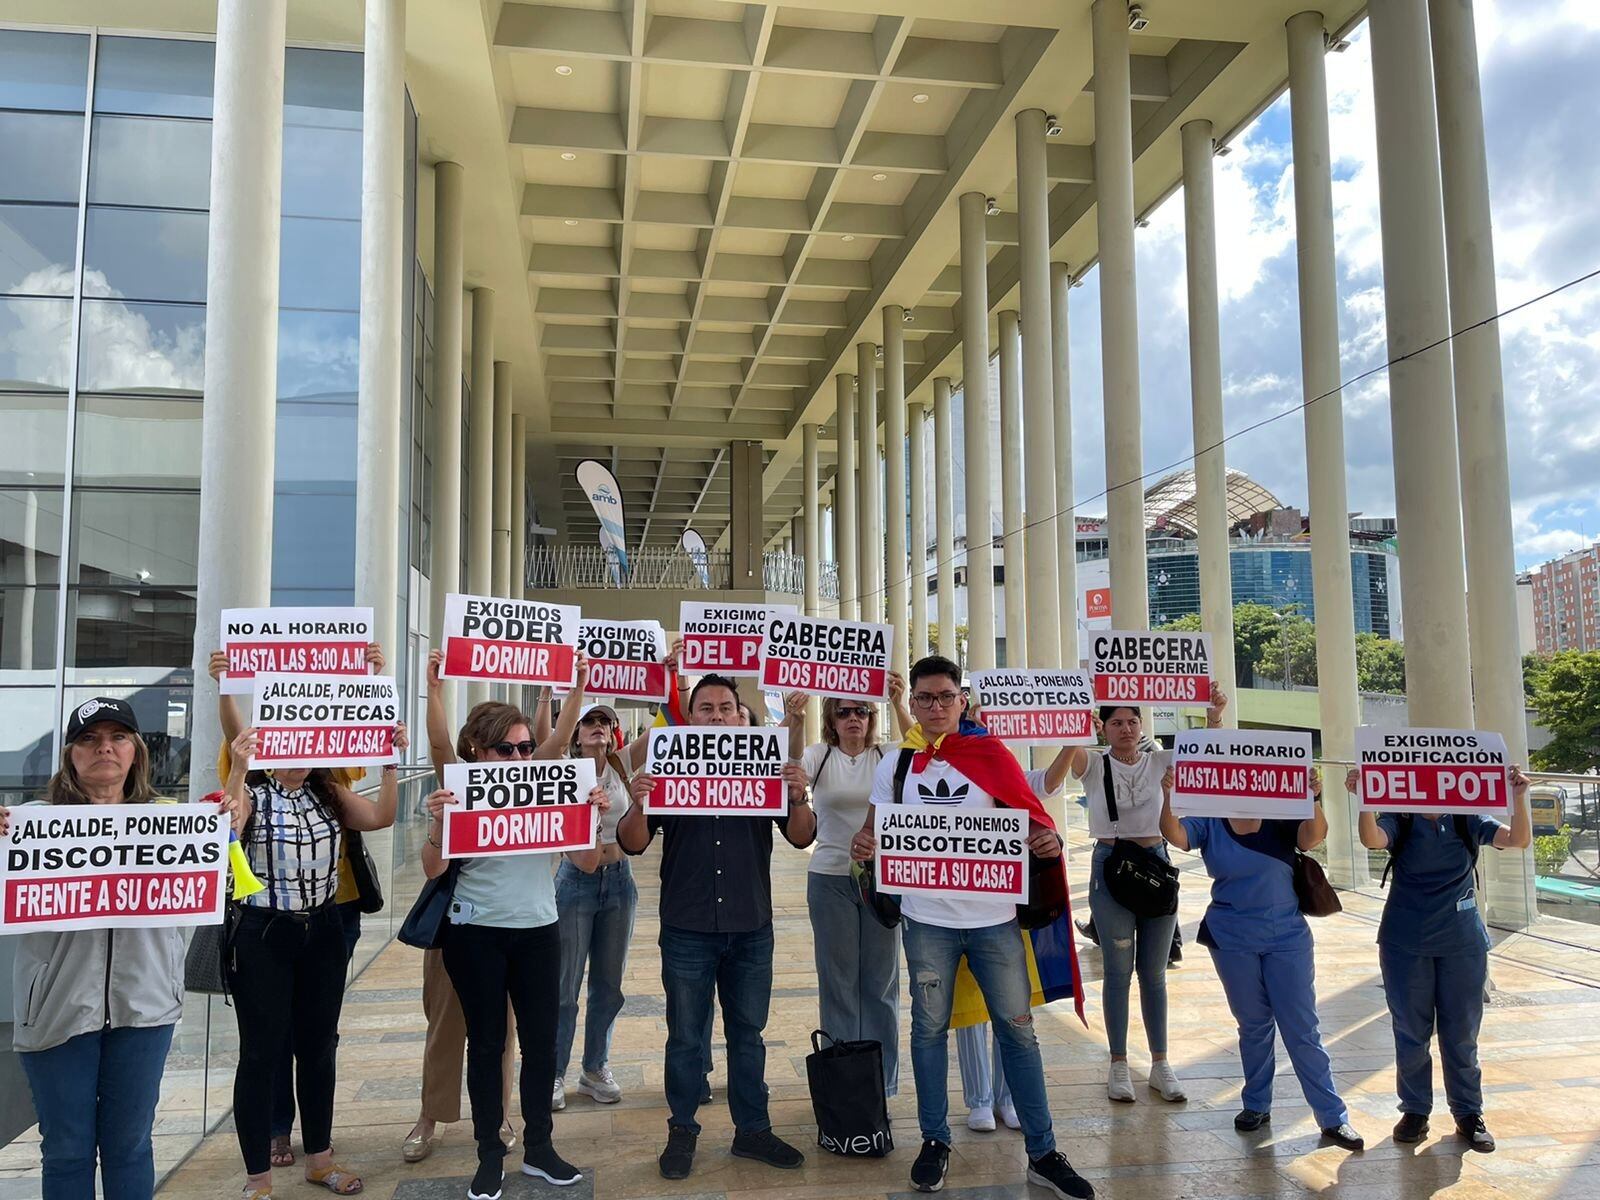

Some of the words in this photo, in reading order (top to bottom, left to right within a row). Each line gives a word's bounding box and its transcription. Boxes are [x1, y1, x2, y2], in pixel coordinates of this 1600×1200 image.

[592, 494, 617, 504] amb
[1076, 524, 1100, 532] KFC
[467, 601, 560, 622] EXIGIMOS
[704, 610, 765, 620] EXIGIMO
[228, 624, 253, 634] NO
[260, 623, 282, 634] AL
[290, 623, 366, 634] HORARIO
[463, 616, 562, 643] PODER
[579, 627, 654, 642] EXIGIMOS
[686, 623, 764, 634] MODIFICAC
[770, 620, 885, 652] CABECERA
[230, 649, 276, 672] HASTA
[281, 648, 306, 670] LAS
[310, 648, 337, 670] 3:00
[341, 648, 364, 670] A.M
[471, 644, 549, 676] DORMIR
[578, 638, 656, 662] PODER
[686, 640, 732, 664] DEL
[768, 644, 811, 660] SOLO
[817, 650, 885, 667] DUERME
[1095, 637, 1207, 661] CABECERA
[778, 662, 810, 686] DOS
[816, 666, 869, 692] HORAS
[1096, 661, 1137, 673] SOLO
[1144, 662, 1208, 674] DUERME
[263, 683, 333, 700] ¿ALCALDE,
[338, 684, 392, 698] PONEMOS
[980, 676, 1033, 689] ¿ALCALDE,
[1034, 676, 1083, 686] PONEMOS
[1108, 677, 1138, 698] DOS
[1144, 678, 1195, 699] HORAS
[980, 692, 1090, 706] DISCOTECAS
[260, 705, 394, 720] DISCOTECAS
[987, 714, 1028, 735] FRENTE
[1031, 714, 1037, 734] A
[1039, 714, 1052, 734] SU
[1056, 713, 1086, 734] CASA?
[262, 733, 314, 756] FRENTE
[315, 733, 325, 754] A
[328, 730, 346, 754] SU
[348, 730, 386, 753] CASA?
[654, 734, 781, 760] CABECERA
[1178, 744, 1198, 754] NO
[1204, 744, 1224, 755] AL
[1230, 744, 1305, 758] HORARIO
[1384, 736, 1478, 747] EXIGIMOS
[1362, 749, 1503, 764] MODIFICACIÓN
[469, 765, 576, 784] EXIGIMOS
[652, 762, 699, 775] SOLO
[706, 762, 780, 776] DUERME
[1179, 767, 1219, 788] HASTA
[1224, 769, 1246, 790] LAS
[1251, 770, 1276, 791] 3:00
[1281, 772, 1303, 792] A.M
[466, 781, 578, 810] PODER
[665, 780, 700, 806] DOS
[706, 780, 765, 806] HORAS
[1366, 771, 1426, 798] DEL
[1438, 772, 1500, 800] POT
[12, 818, 118, 844] ¿ALCALDE,
[126, 815, 217, 835] PONEMOS
[478, 812, 564, 846] DORMIR
[882, 814, 950, 832] ¿ALCALDE,
[956, 816, 1019, 832] PONEMOS
[881, 834, 1022, 855] DISCOTECAS
[8, 843, 219, 871] DISCOTECAS
[888, 860, 936, 884] FRENTE
[940, 862, 948, 885] A
[952, 862, 968, 886] SU
[974, 864, 1014, 888] CASA?
[16, 881, 92, 917] FRENTE
[96, 880, 110, 911] A
[116, 879, 141, 910] SU
[147, 876, 206, 910] CASA?
